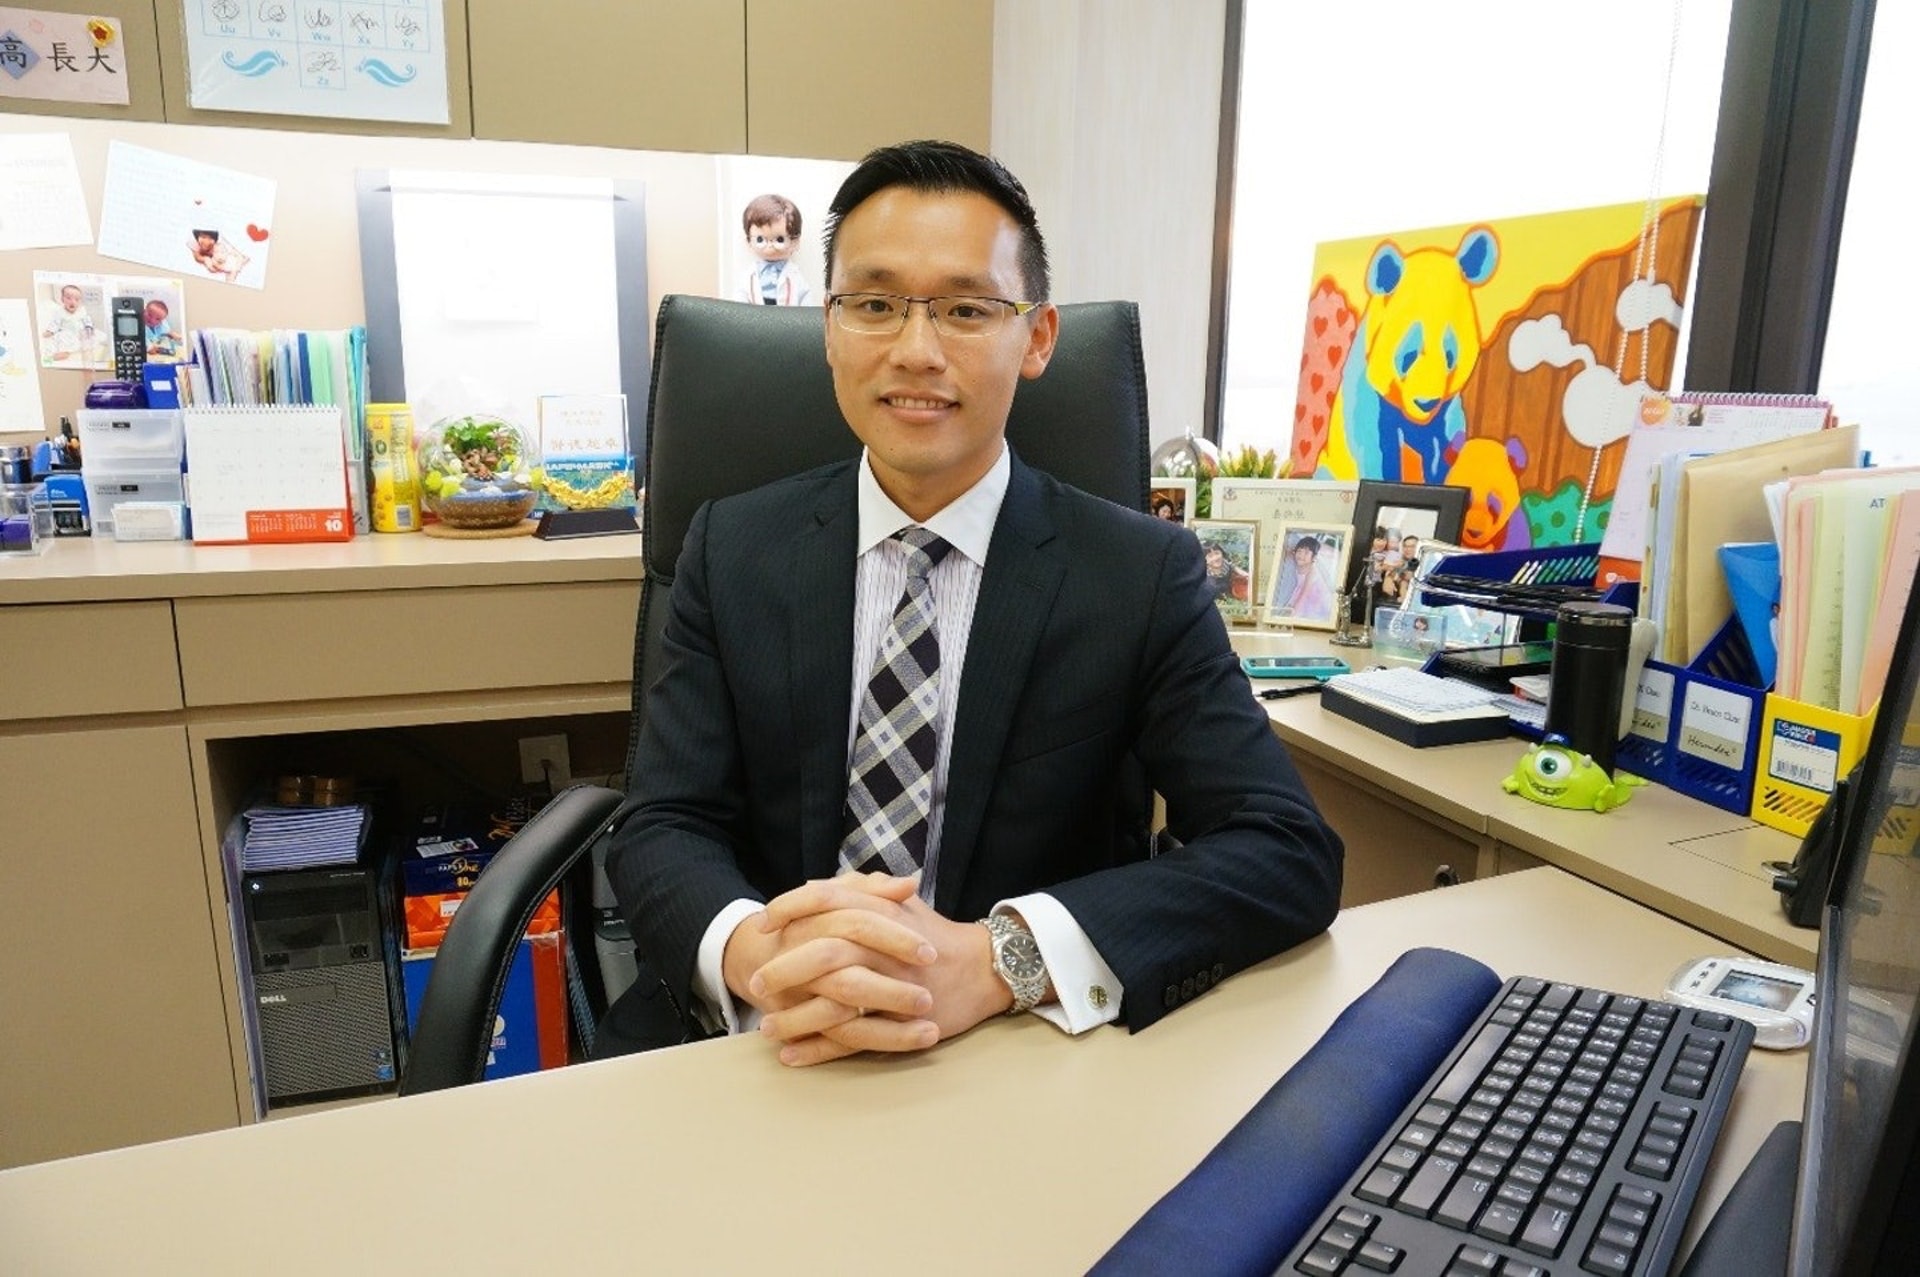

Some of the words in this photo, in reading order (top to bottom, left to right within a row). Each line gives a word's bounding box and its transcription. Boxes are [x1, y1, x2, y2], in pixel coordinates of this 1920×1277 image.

[1869, 498, 1886, 509] AT
[324, 518, 344, 532] 10
[260, 995, 287, 1004] DELL
